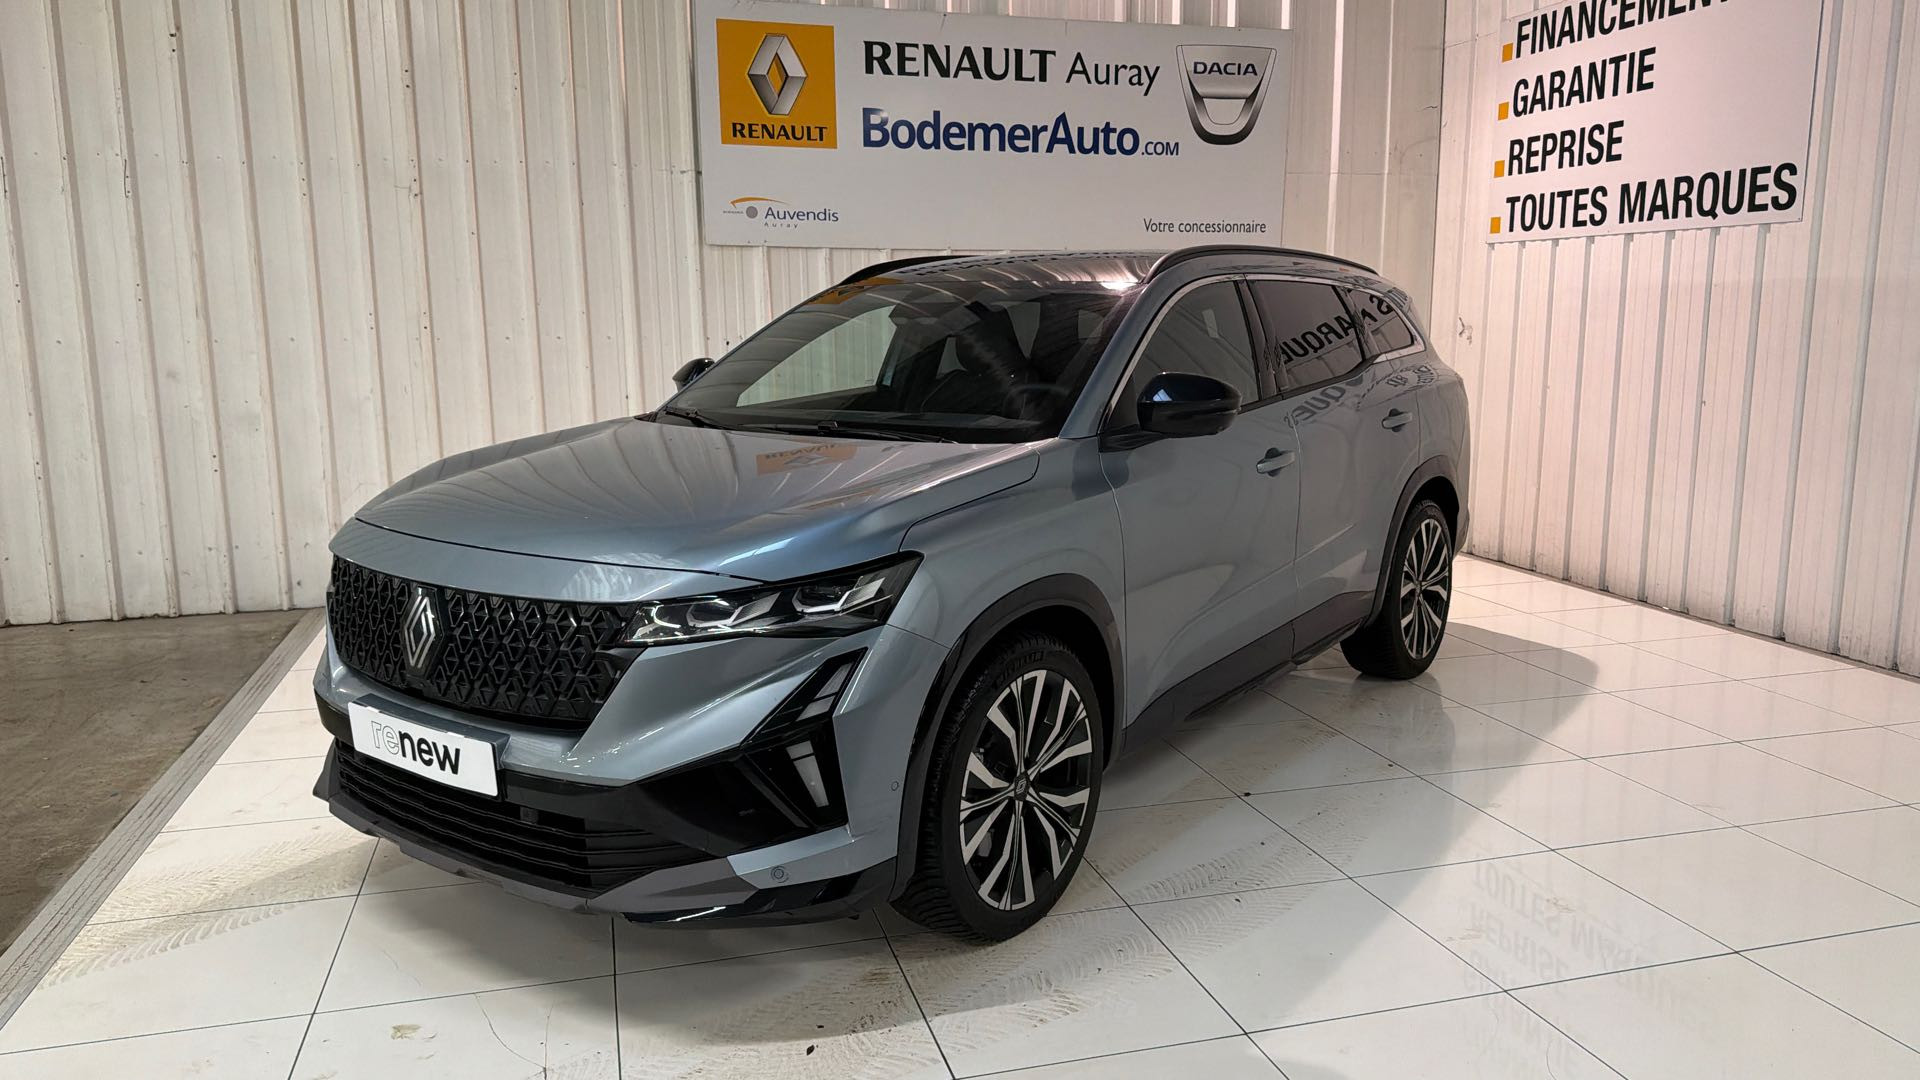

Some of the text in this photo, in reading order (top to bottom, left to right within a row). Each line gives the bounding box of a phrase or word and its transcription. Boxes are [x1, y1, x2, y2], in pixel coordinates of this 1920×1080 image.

[1516, 0, 1728, 59] FINANCEM
[863, 40, 1160, 97] RENAULT Auray
[1193, 61, 1259, 77] DACIA
[1513, 46, 1657, 118] GARANTIE
[731, 121, 828, 142] RENAULT
[1508, 120, 1625, 176] REPRISE
[764, 206, 839, 222] Auvendis
[764, 221, 799, 229] Auray
[1506, 162, 1798, 233] TOUTES MARQUES
[1143, 217, 1267, 234] Votre concessionnaire
[371, 720, 461, 775] renew
